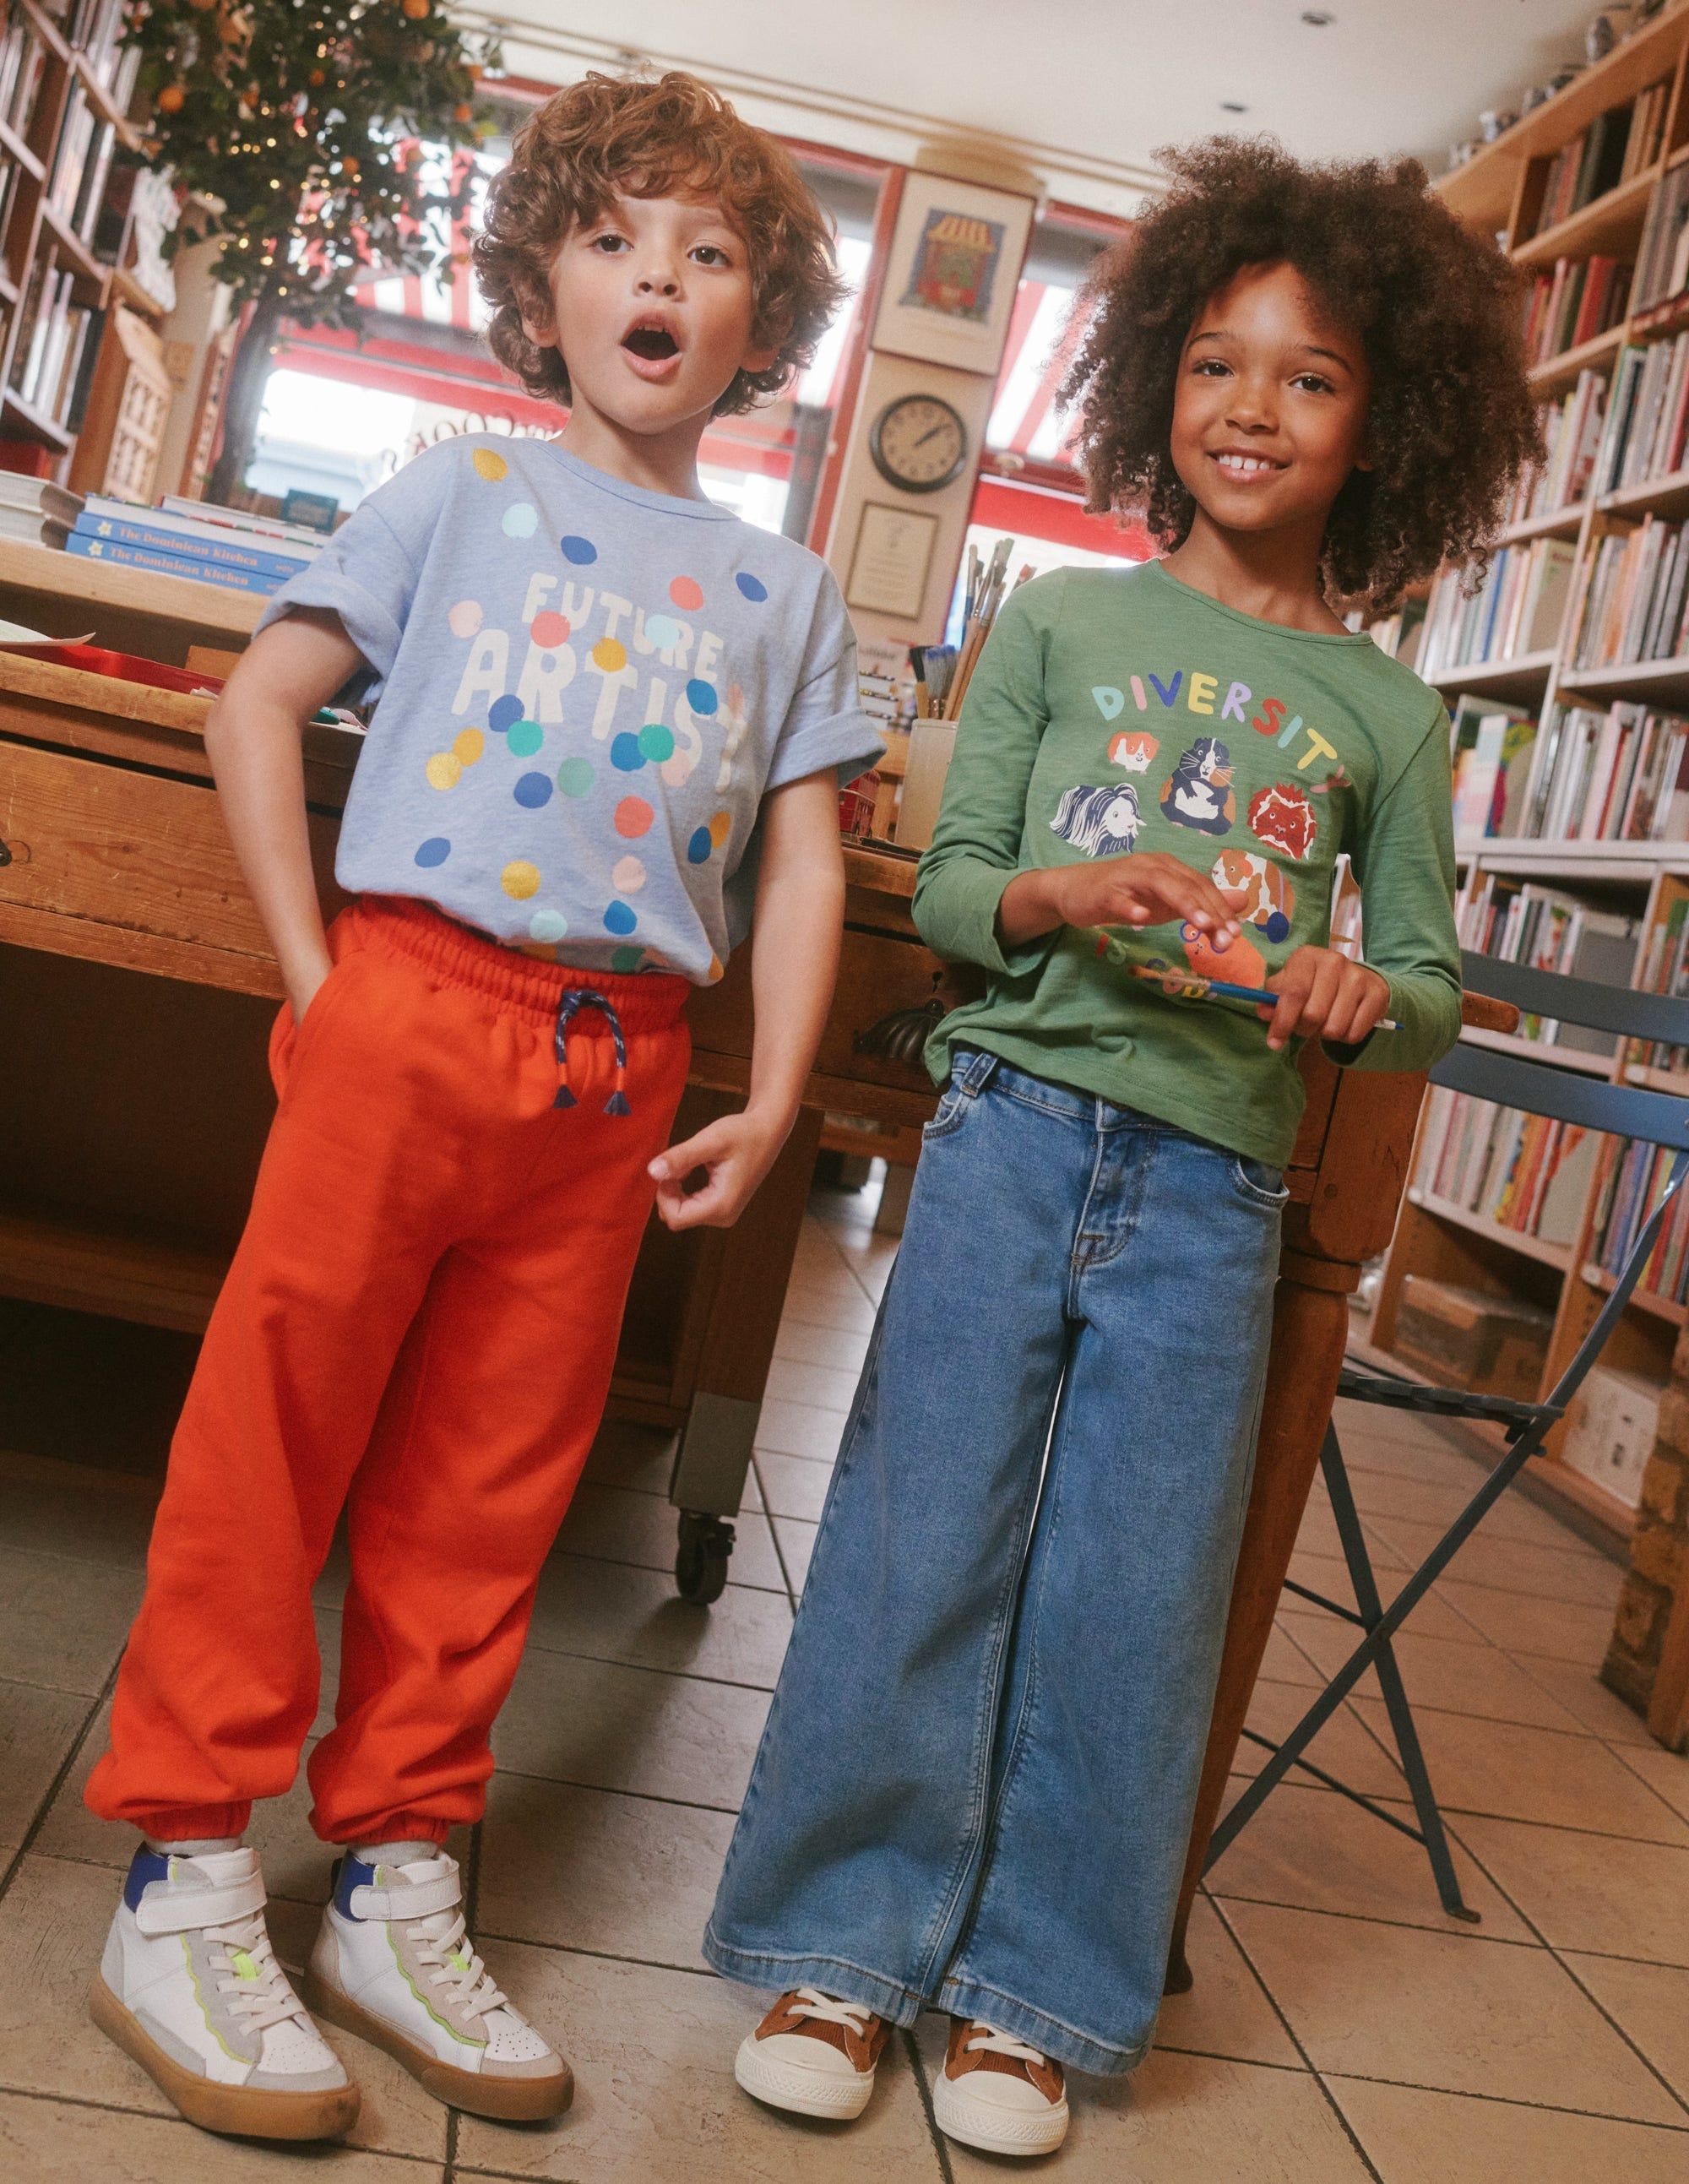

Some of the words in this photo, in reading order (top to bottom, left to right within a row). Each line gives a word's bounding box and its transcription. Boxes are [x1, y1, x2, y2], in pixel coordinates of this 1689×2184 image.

[111, 547, 131, 561] The
[133, 551, 199, 576] Dominican
[204, 567, 249, 587] Kitchen
[119, 526, 142, 541] The
[143, 531, 209, 557] Dominican
[213, 547, 258, 567] Kitchen
[521, 572, 724, 683] FUTURE
[451, 628, 747, 794] ARTIST
[1091, 671, 1350, 794] DIVERSITY
